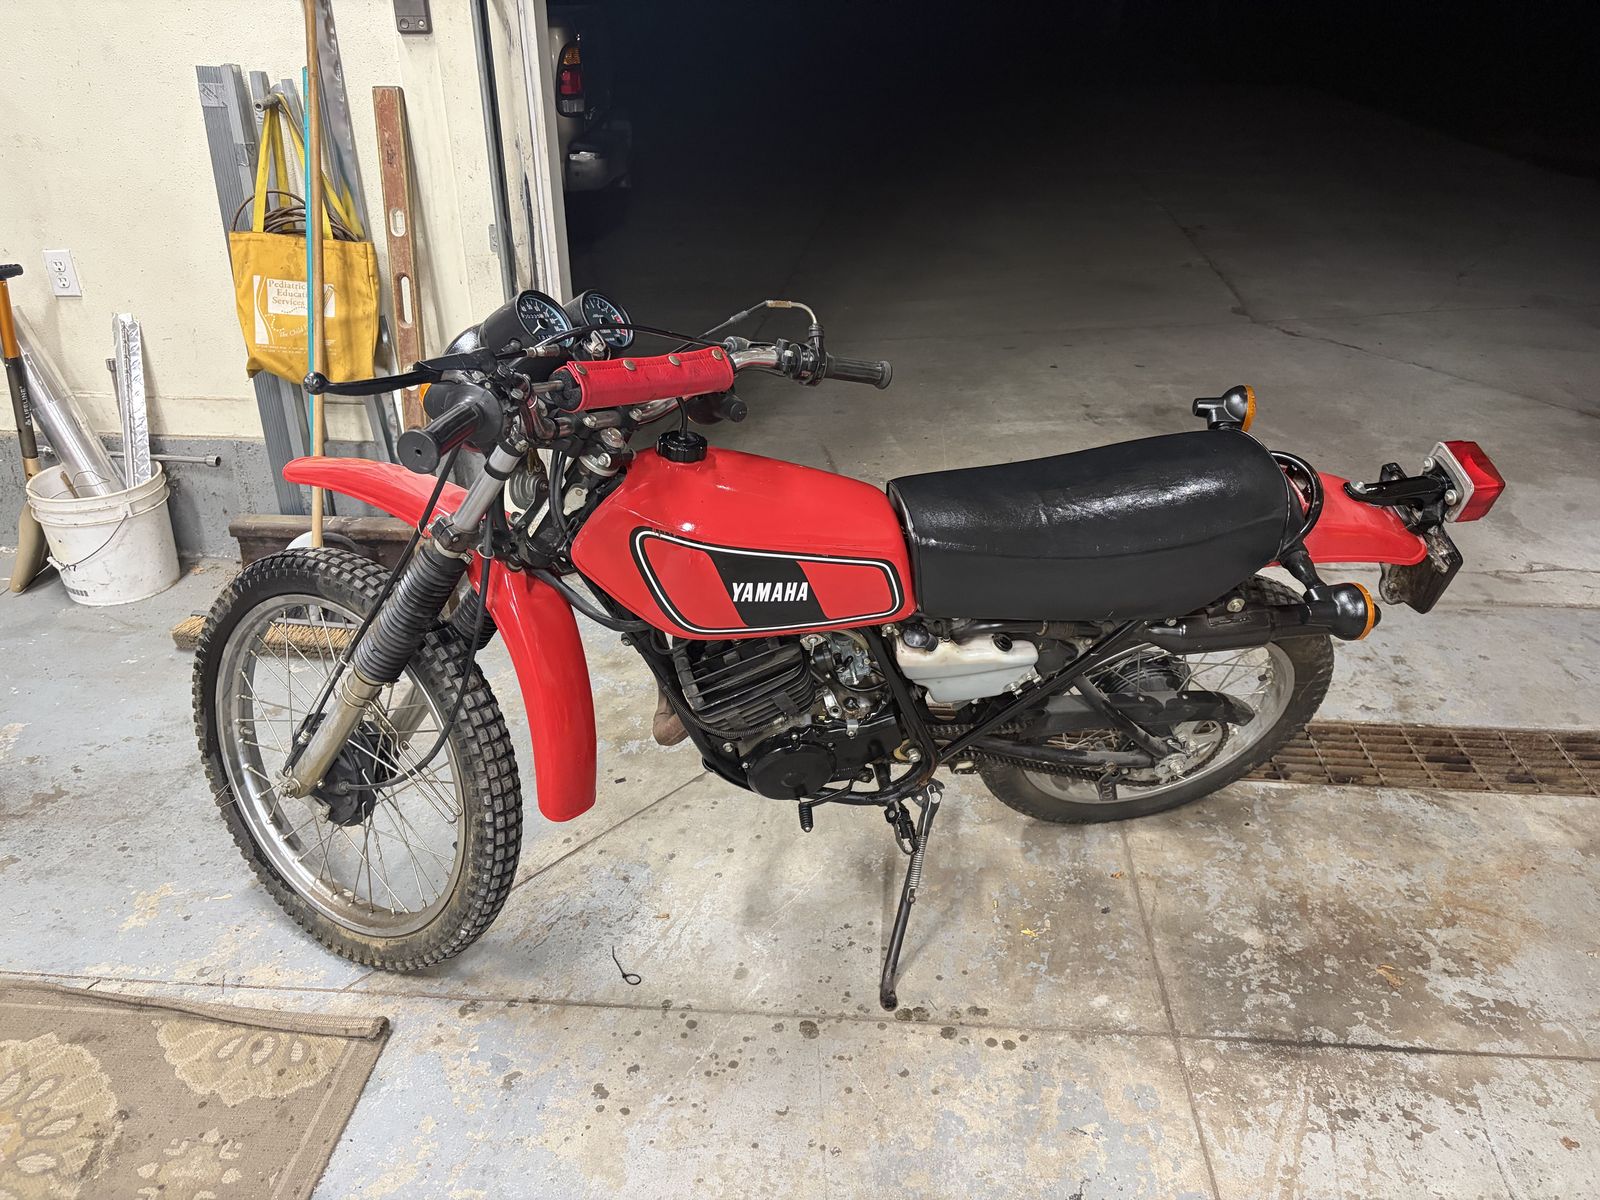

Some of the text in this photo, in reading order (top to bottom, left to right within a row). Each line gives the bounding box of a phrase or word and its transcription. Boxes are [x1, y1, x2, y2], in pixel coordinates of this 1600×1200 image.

[268, 280, 306, 290] Pediatric
[276, 288, 307, 298] Educat
[271, 296, 305, 306] Services
[732, 582, 809, 602] YAMAHA
